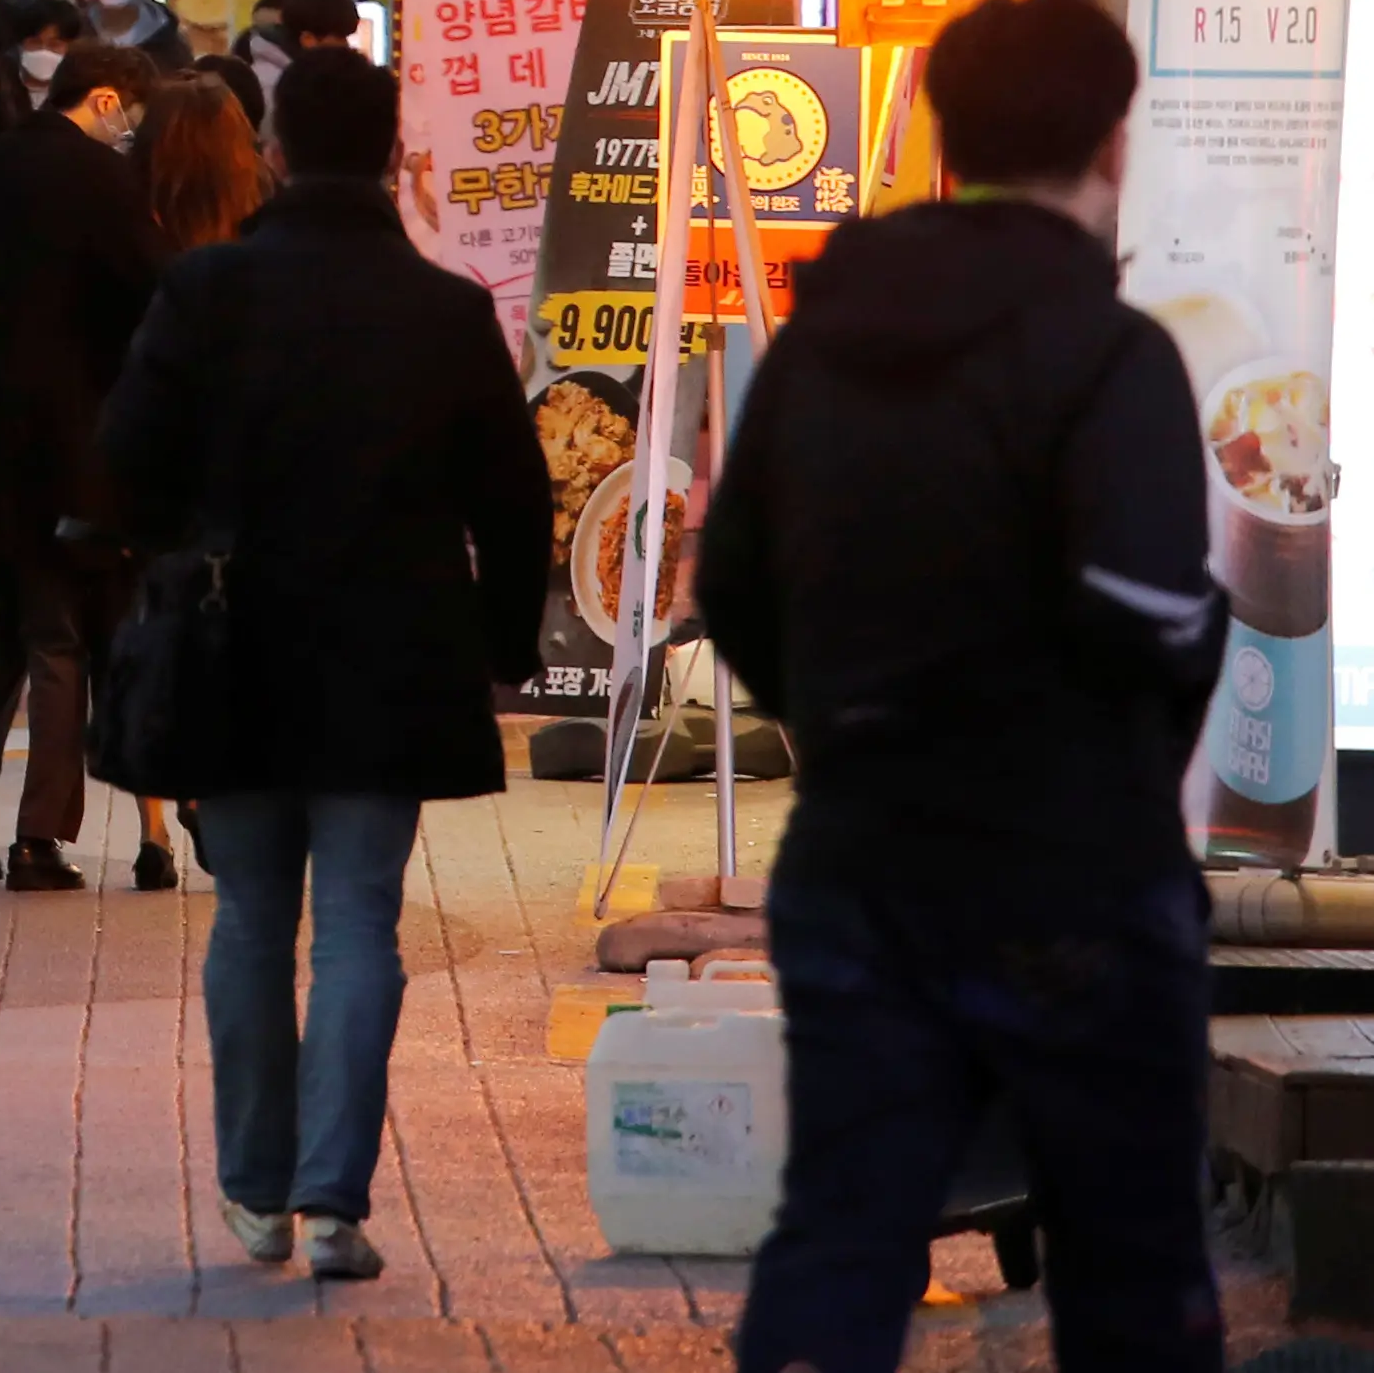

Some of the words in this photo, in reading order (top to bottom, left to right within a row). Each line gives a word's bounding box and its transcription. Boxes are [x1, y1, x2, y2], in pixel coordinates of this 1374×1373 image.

[1194, 6, 1207, 44] R
[1214, 6, 1242, 44] 1.5
[1267, 6, 1280, 44] V
[1286, 6, 1318, 44] 2.0
[741, 52, 770, 62] SINCE
[770, 195, 801, 212] 원조
[459, 228, 493, 248] 다른
[544, 668, 586, 696] 포장
